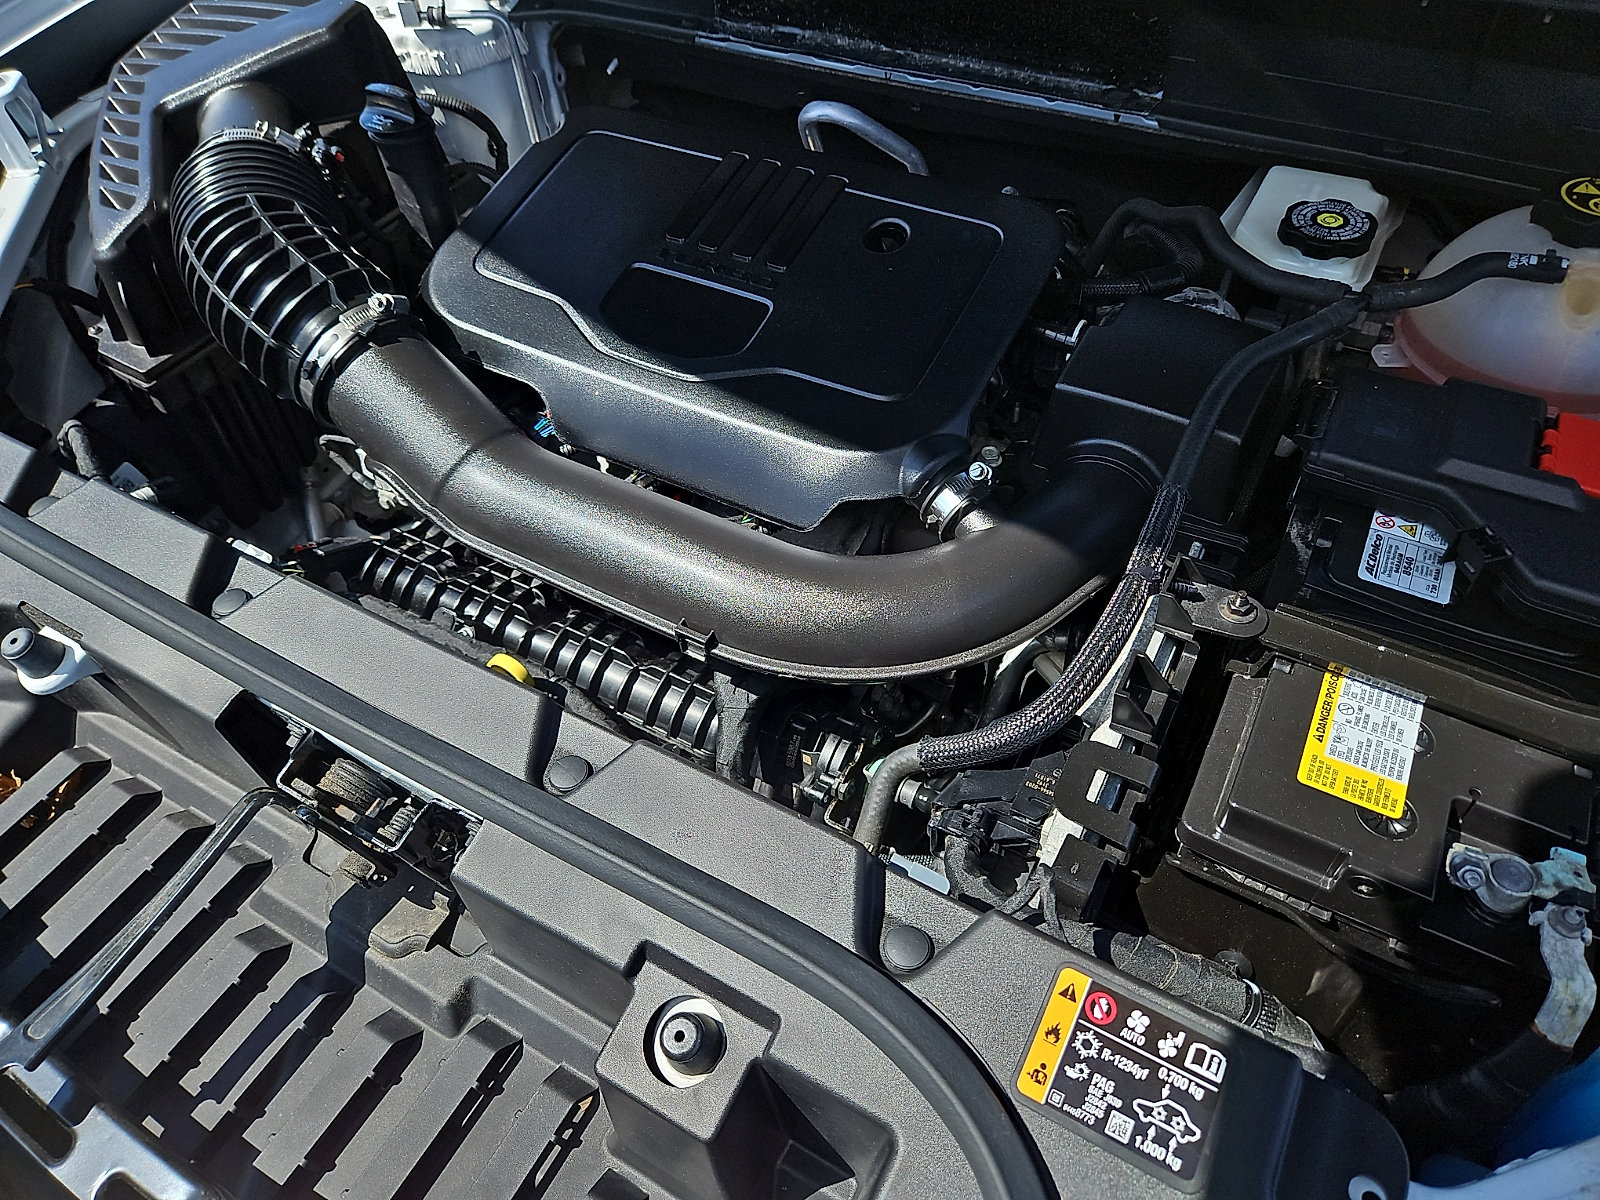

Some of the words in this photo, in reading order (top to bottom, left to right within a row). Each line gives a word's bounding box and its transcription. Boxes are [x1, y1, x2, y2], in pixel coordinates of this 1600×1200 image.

[1365, 534, 1383, 575] ACDelco
[1403, 556, 1415, 576] 8540
[1120, 1028, 1146, 1046] AUTO
[1101, 1048, 1150, 1080] R-1234yf
[1091, 1073, 1115, 1094] PAG
[1158, 1066, 1190, 1092] 0.700
[1189, 1082, 1205, 1101] kg
[1135, 1135, 1166, 1159] 1.000
[1165, 1152, 1182, 1171] kg
